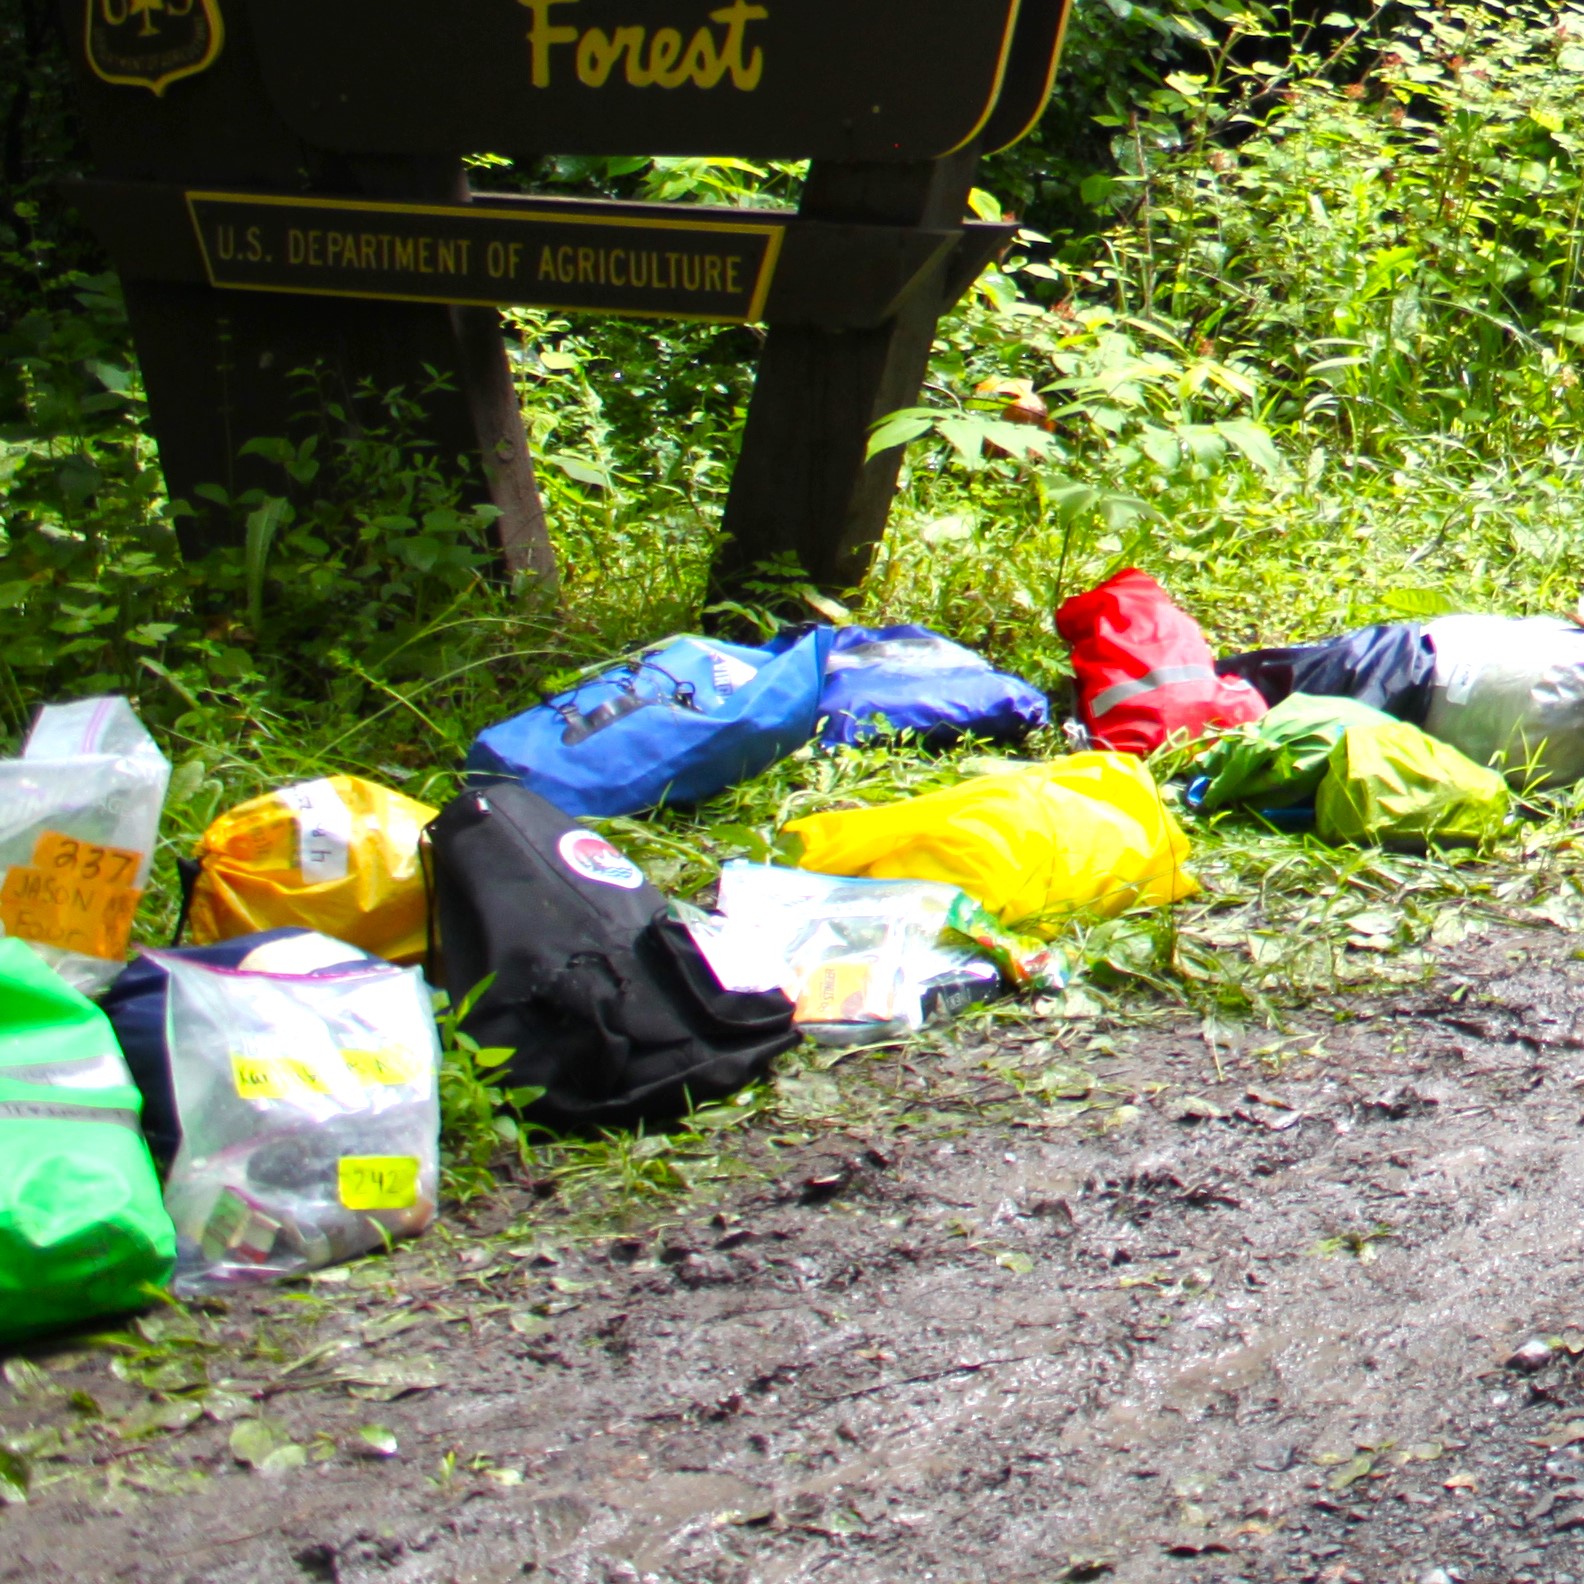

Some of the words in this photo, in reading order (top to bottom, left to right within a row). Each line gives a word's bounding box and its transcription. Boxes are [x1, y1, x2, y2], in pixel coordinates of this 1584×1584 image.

[217, 226, 274, 264] U.S.
[289, 230, 470, 274] DEPARTMENT
[487, 241, 523, 278] OF
[539, 247, 744, 294] AGRICULTURE
[55, 839, 134, 884] 237
[352, 1167, 400, 1194] 242
